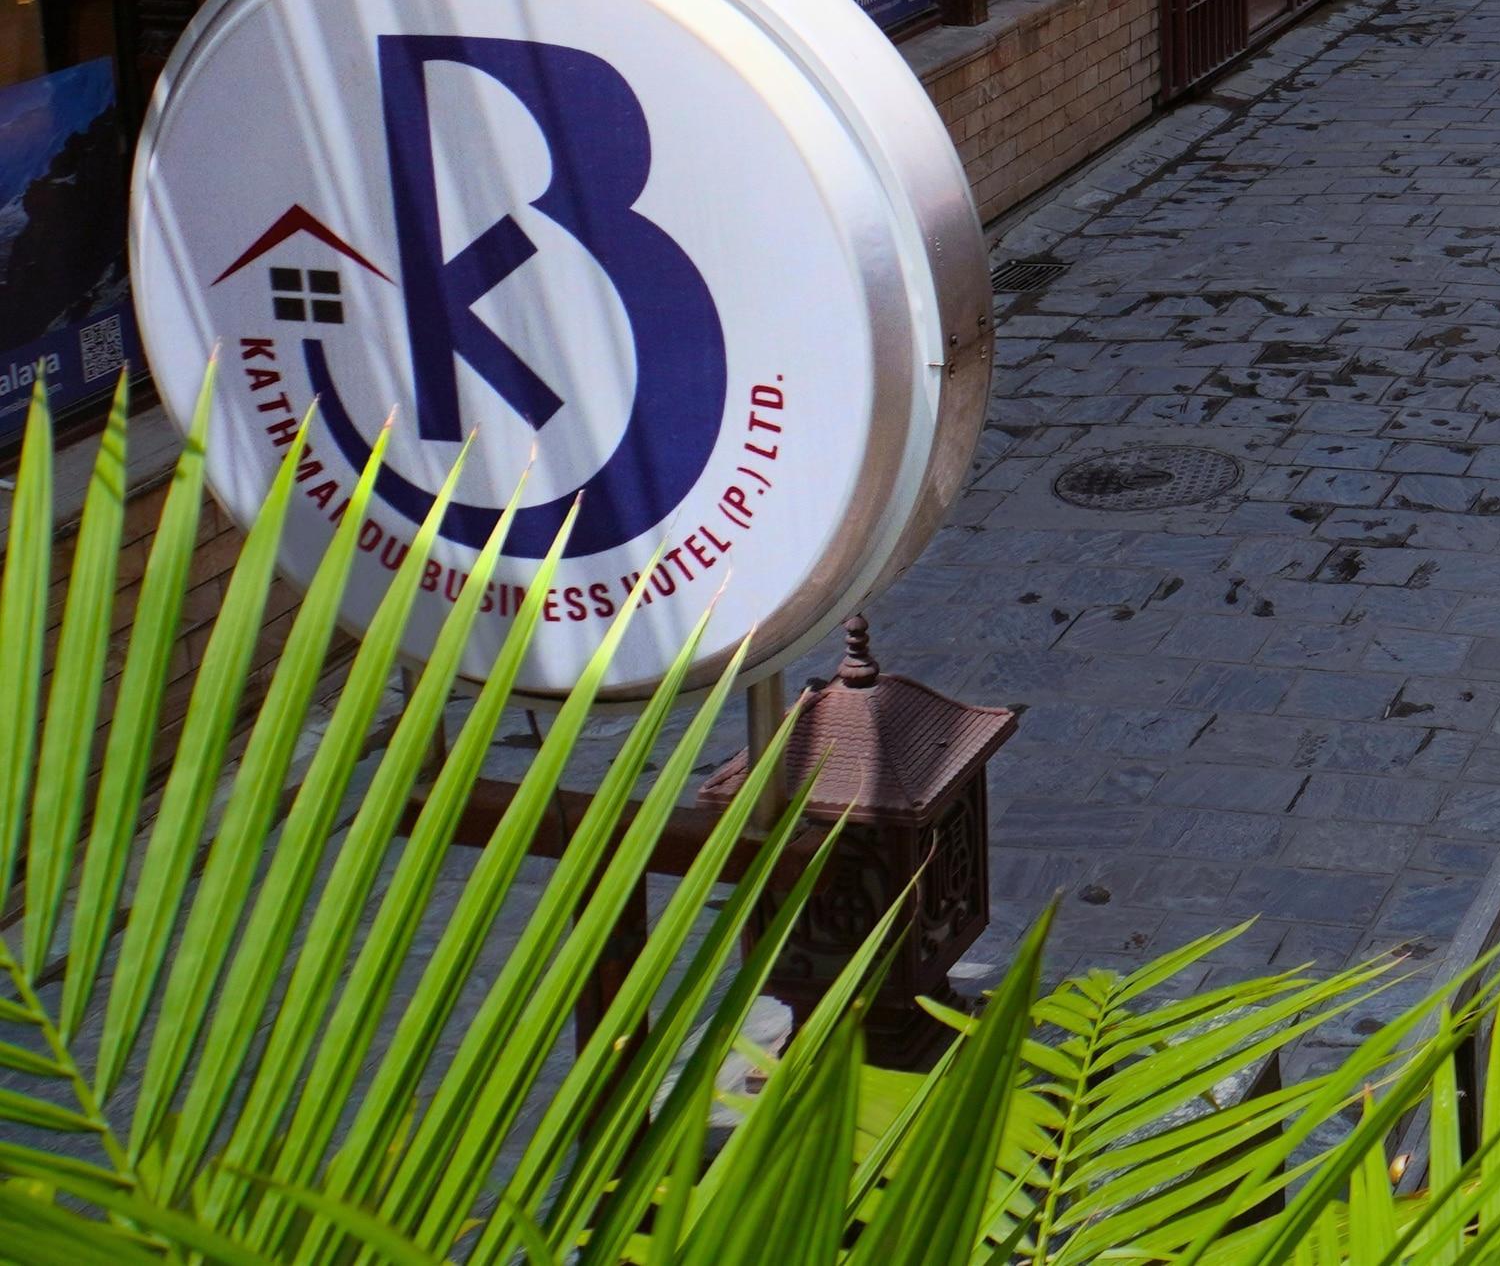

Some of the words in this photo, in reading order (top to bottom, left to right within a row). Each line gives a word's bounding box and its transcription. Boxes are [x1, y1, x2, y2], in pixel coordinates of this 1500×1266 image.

[420, 558, 615, 622] BUSINESS
[620, 526, 732, 609] HOTEL
[744, 374, 784, 460] LTD.
